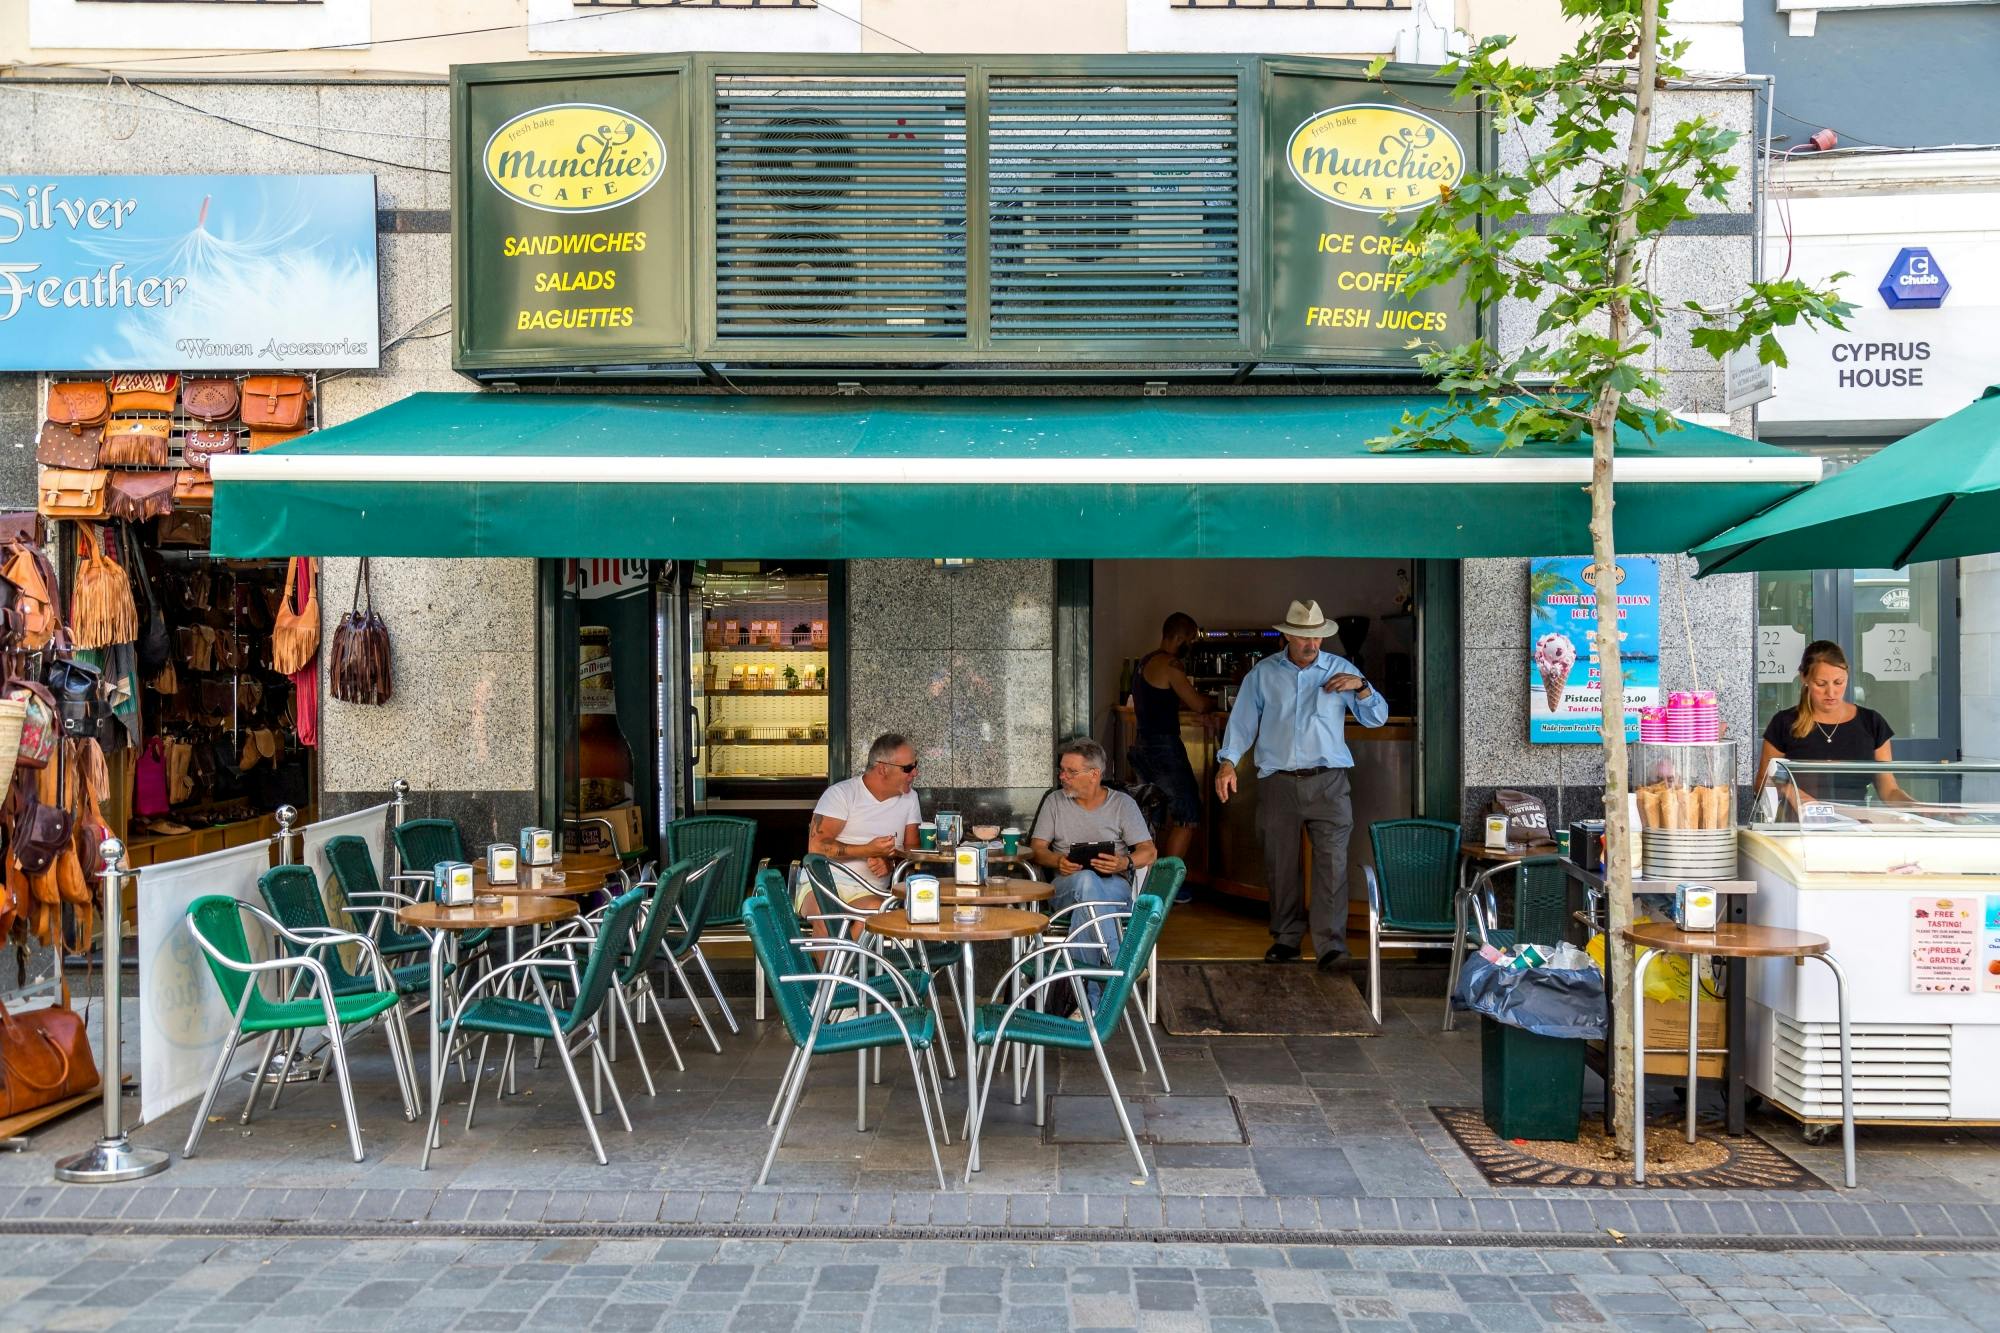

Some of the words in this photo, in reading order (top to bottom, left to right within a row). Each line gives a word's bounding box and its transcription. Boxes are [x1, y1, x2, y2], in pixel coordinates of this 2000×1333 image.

[508, 124, 531, 142] fresh
[533, 117, 555, 129] bake
[1311, 120, 1334, 137] fresh
[1335, 115, 1357, 128] bake
[528, 181, 618, 201] CAFE
[1333, 181, 1420, 200] CAFE
[0, 184, 137, 244] Silver
[503, 231, 647, 257] SANDWICHES
[1318, 233, 1354, 254] ICE
[534, 270, 617, 292] SALADS
[1337, 271, 1408, 293] COFFE
[1900, 275, 1938, 285] Chubb
[0, 262, 187, 322] Feather
[517, 306, 634, 330] BAGUETTES
[1306, 306, 1371, 328] FRESH
[1375, 310, 1448, 331] JUICES
[176, 338, 253, 359] Women
[258, 337, 368, 360] Accessories
[1831, 342, 1931, 362] CYPRUS
[1839, 368, 1923, 388] HOUSE
[1547, 595, 1578, 606] HOME
[1581, 595, 1597, 606] MA
[1571, 609, 1588, 619] ICE
[1761, 631, 1781, 645] 22
[1887, 629, 1906, 643] 22
[1767, 650, 1775, 658] &
[1892, 647, 1902, 656] &
[1758, 660, 1785, 674] 22a
[1883, 658, 1911, 672] 22a
[1541, 723, 1557, 732] Made
[1558, 723, 1573, 734] from
[1574, 723, 1590, 732] Fresh
[1927, 920, 1962, 928] TASTING!
